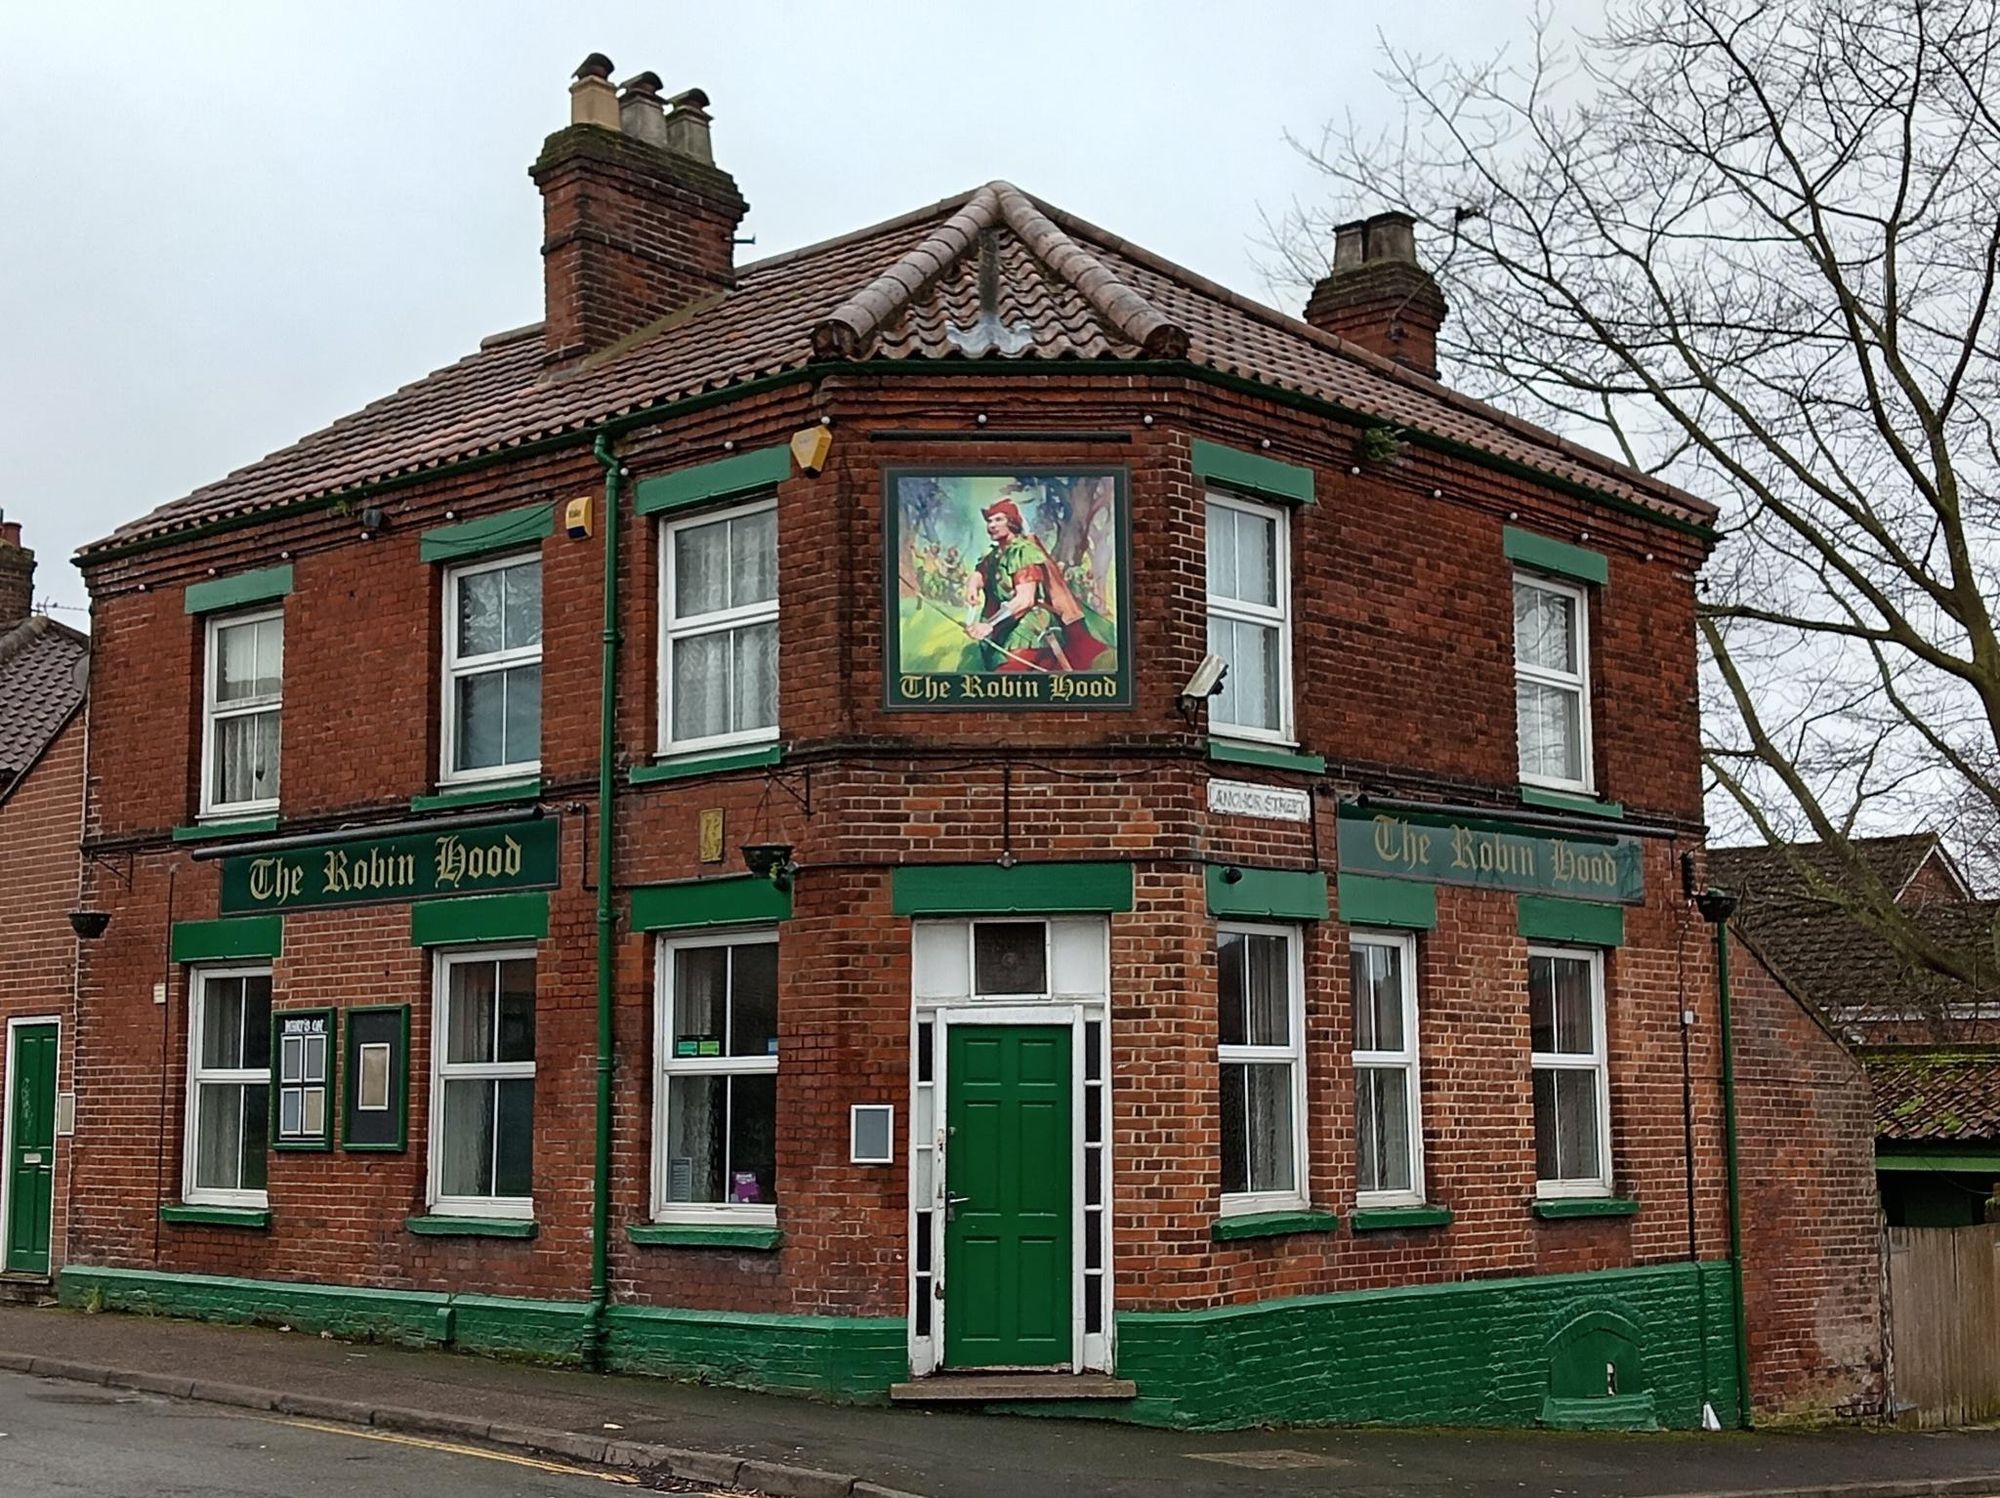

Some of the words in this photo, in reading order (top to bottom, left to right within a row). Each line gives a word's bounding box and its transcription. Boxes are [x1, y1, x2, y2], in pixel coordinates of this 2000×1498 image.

[900, 675, 950, 702] The
[961, 674, 1039, 699] Robin
[1049, 674, 1117, 701] Hood
[1264, 795, 1305, 815] STREET
[250, 858, 304, 905] The
[322, 845, 415, 894] Robin
[434, 833, 521, 888] Hood
[1373, 814, 1431, 871] The
[1450, 824, 1536, 877] Robin
[1551, 837, 1617, 887] Hood
